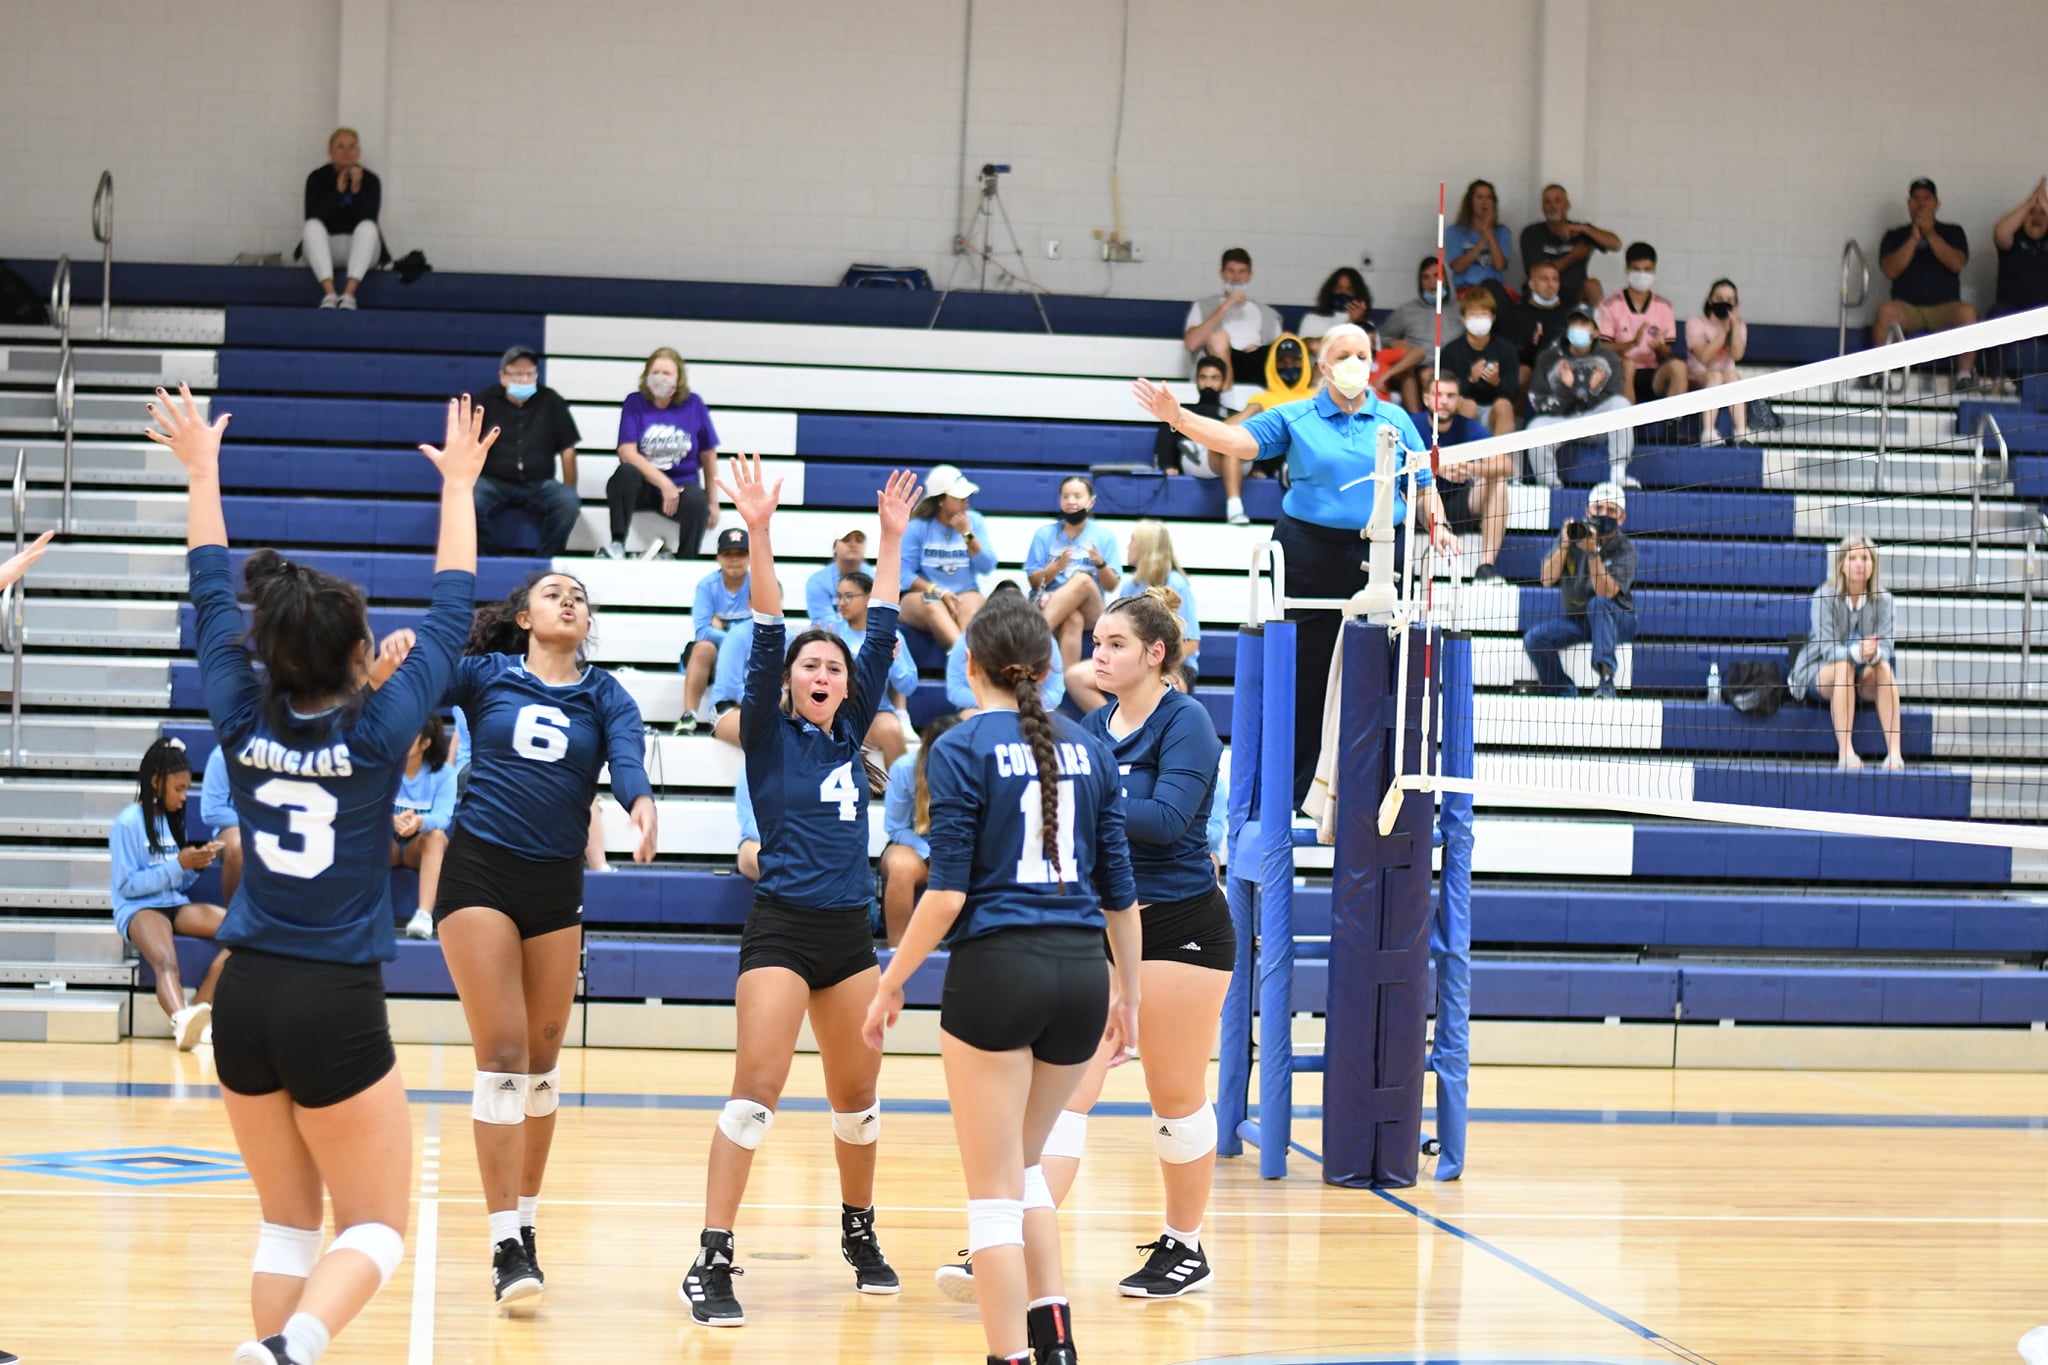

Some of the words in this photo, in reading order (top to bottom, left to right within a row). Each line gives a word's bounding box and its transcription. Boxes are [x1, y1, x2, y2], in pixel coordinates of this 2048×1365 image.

[512, 703, 571, 763] 6
[995, 743, 1091, 778] COURS
[820, 761, 860, 822] 4
[254, 777, 338, 880] 3
[1016, 779, 1079, 884] 11
